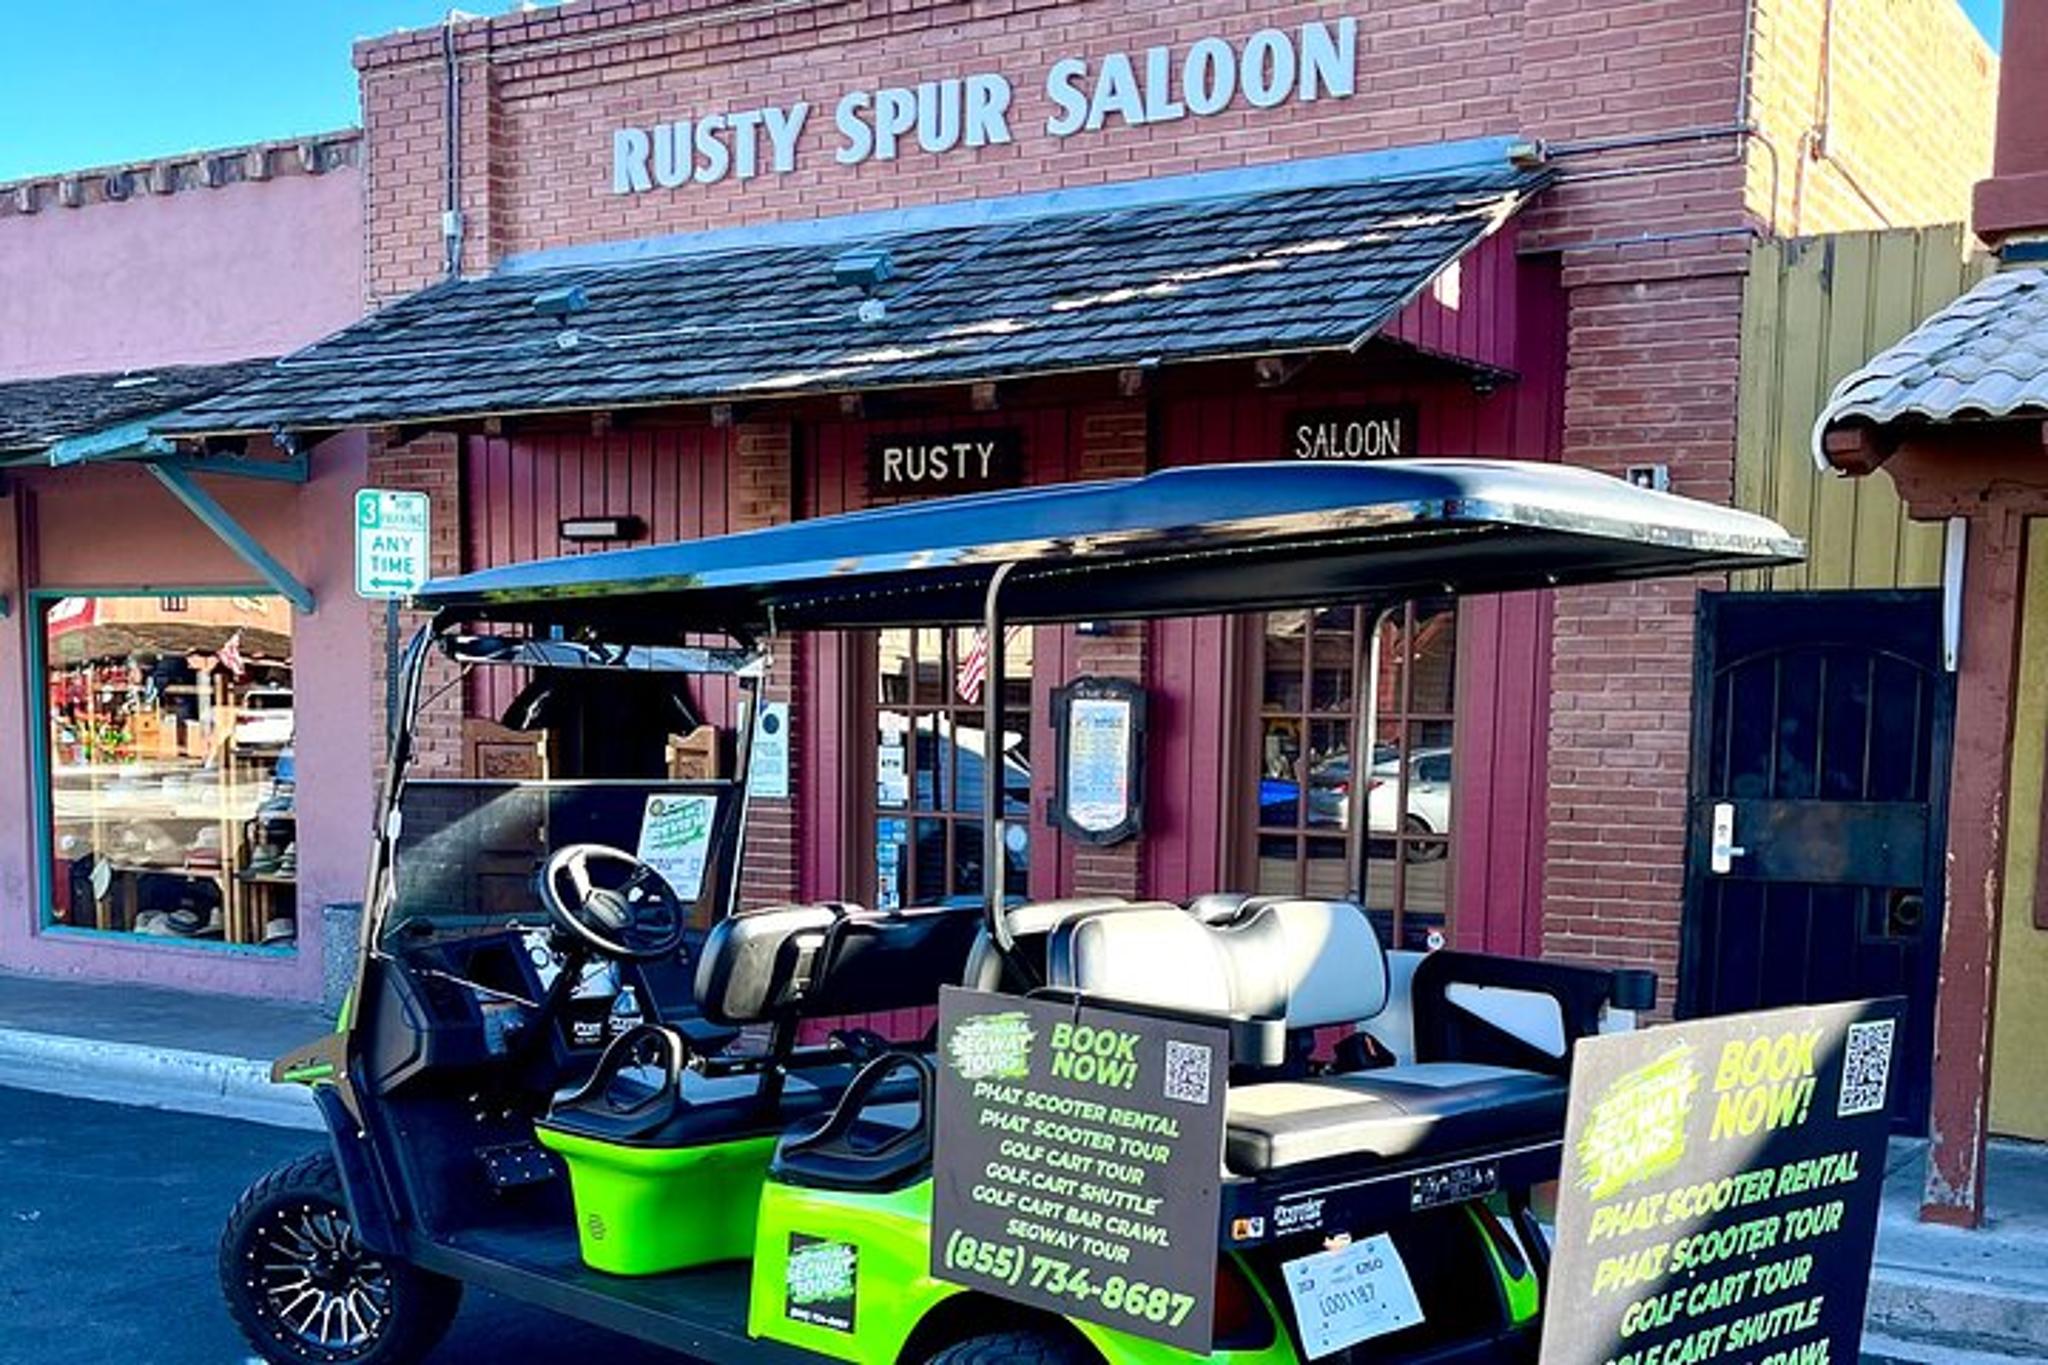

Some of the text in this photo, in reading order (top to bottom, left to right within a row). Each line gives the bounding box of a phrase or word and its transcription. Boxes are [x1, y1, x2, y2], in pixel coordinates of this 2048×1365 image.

[613, 15, 1358, 195] RUSTY SPUR SALOON
[884, 441, 994, 482] RUSTY
[1296, 417, 1400, 459] SALOON
[363, 500, 377, 525] 3
[370, 556, 415, 575] TIME
[372, 536, 413, 552] ANY
[1050, 1022, 1141, 1062] BOOK
[1713, 1028, 1824, 1092] BOOK
[1051, 1052, 1138, 1090] NOW!
[972, 1081, 1181, 1138] PHAT SCOOTER RENTAL
[980, 1108, 1171, 1164] PHAT SCOOTER TOUR
[1709, 1077, 1817, 1141] NOW!
[1000, 1139, 1145, 1185] GOLF CART TOUR
[972, 1185, 1170, 1247] GOLF CART BAR CRAWL
[1031, 1173, 1078, 1196] CART
[1078, 1183, 1158, 1215] SHUTTLE
[1587, 1151, 1859, 1244] PHAT SCOOTER RENTAL
[1006, 1218, 1131, 1263] SEGWAY TOUR
[1592, 1200, 1845, 1296] PHAT SCOOTER TOUR
[945, 1228, 1196, 1327] (855) 734-8687
[1620, 1254, 1814, 1338] GOLF CART TOUR
[1724, 1296, 1824, 1352] SHUTTLE
